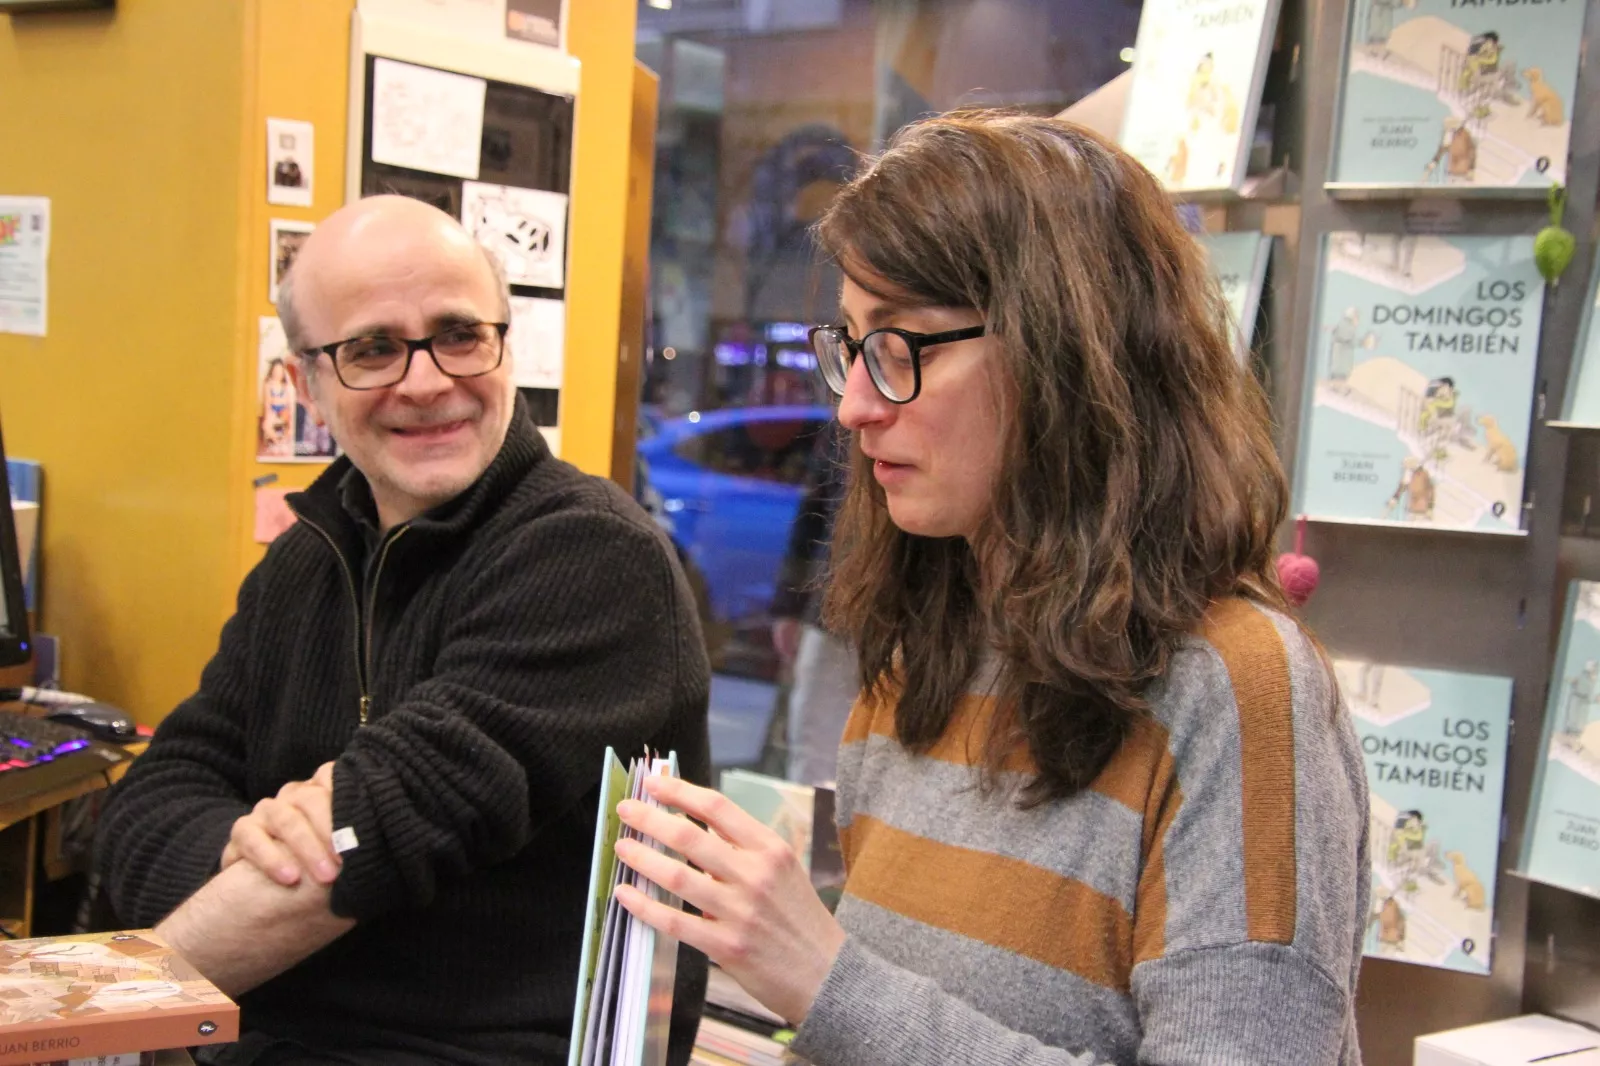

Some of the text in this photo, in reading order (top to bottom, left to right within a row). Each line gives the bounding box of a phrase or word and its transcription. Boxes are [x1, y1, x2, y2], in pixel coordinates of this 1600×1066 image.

[1476, 279, 1526, 301] LOS
[1372, 304, 1523, 328] DOMINGOS
[1406, 327, 1520, 354] TAMBIÉN
[1442, 716, 1491, 742] LOS
[1361, 734, 1488, 768] OMINGOS
[1373, 760, 1486, 793] TAMBIÉN
[0, 1036, 81, 1056] UAN BERRIO
